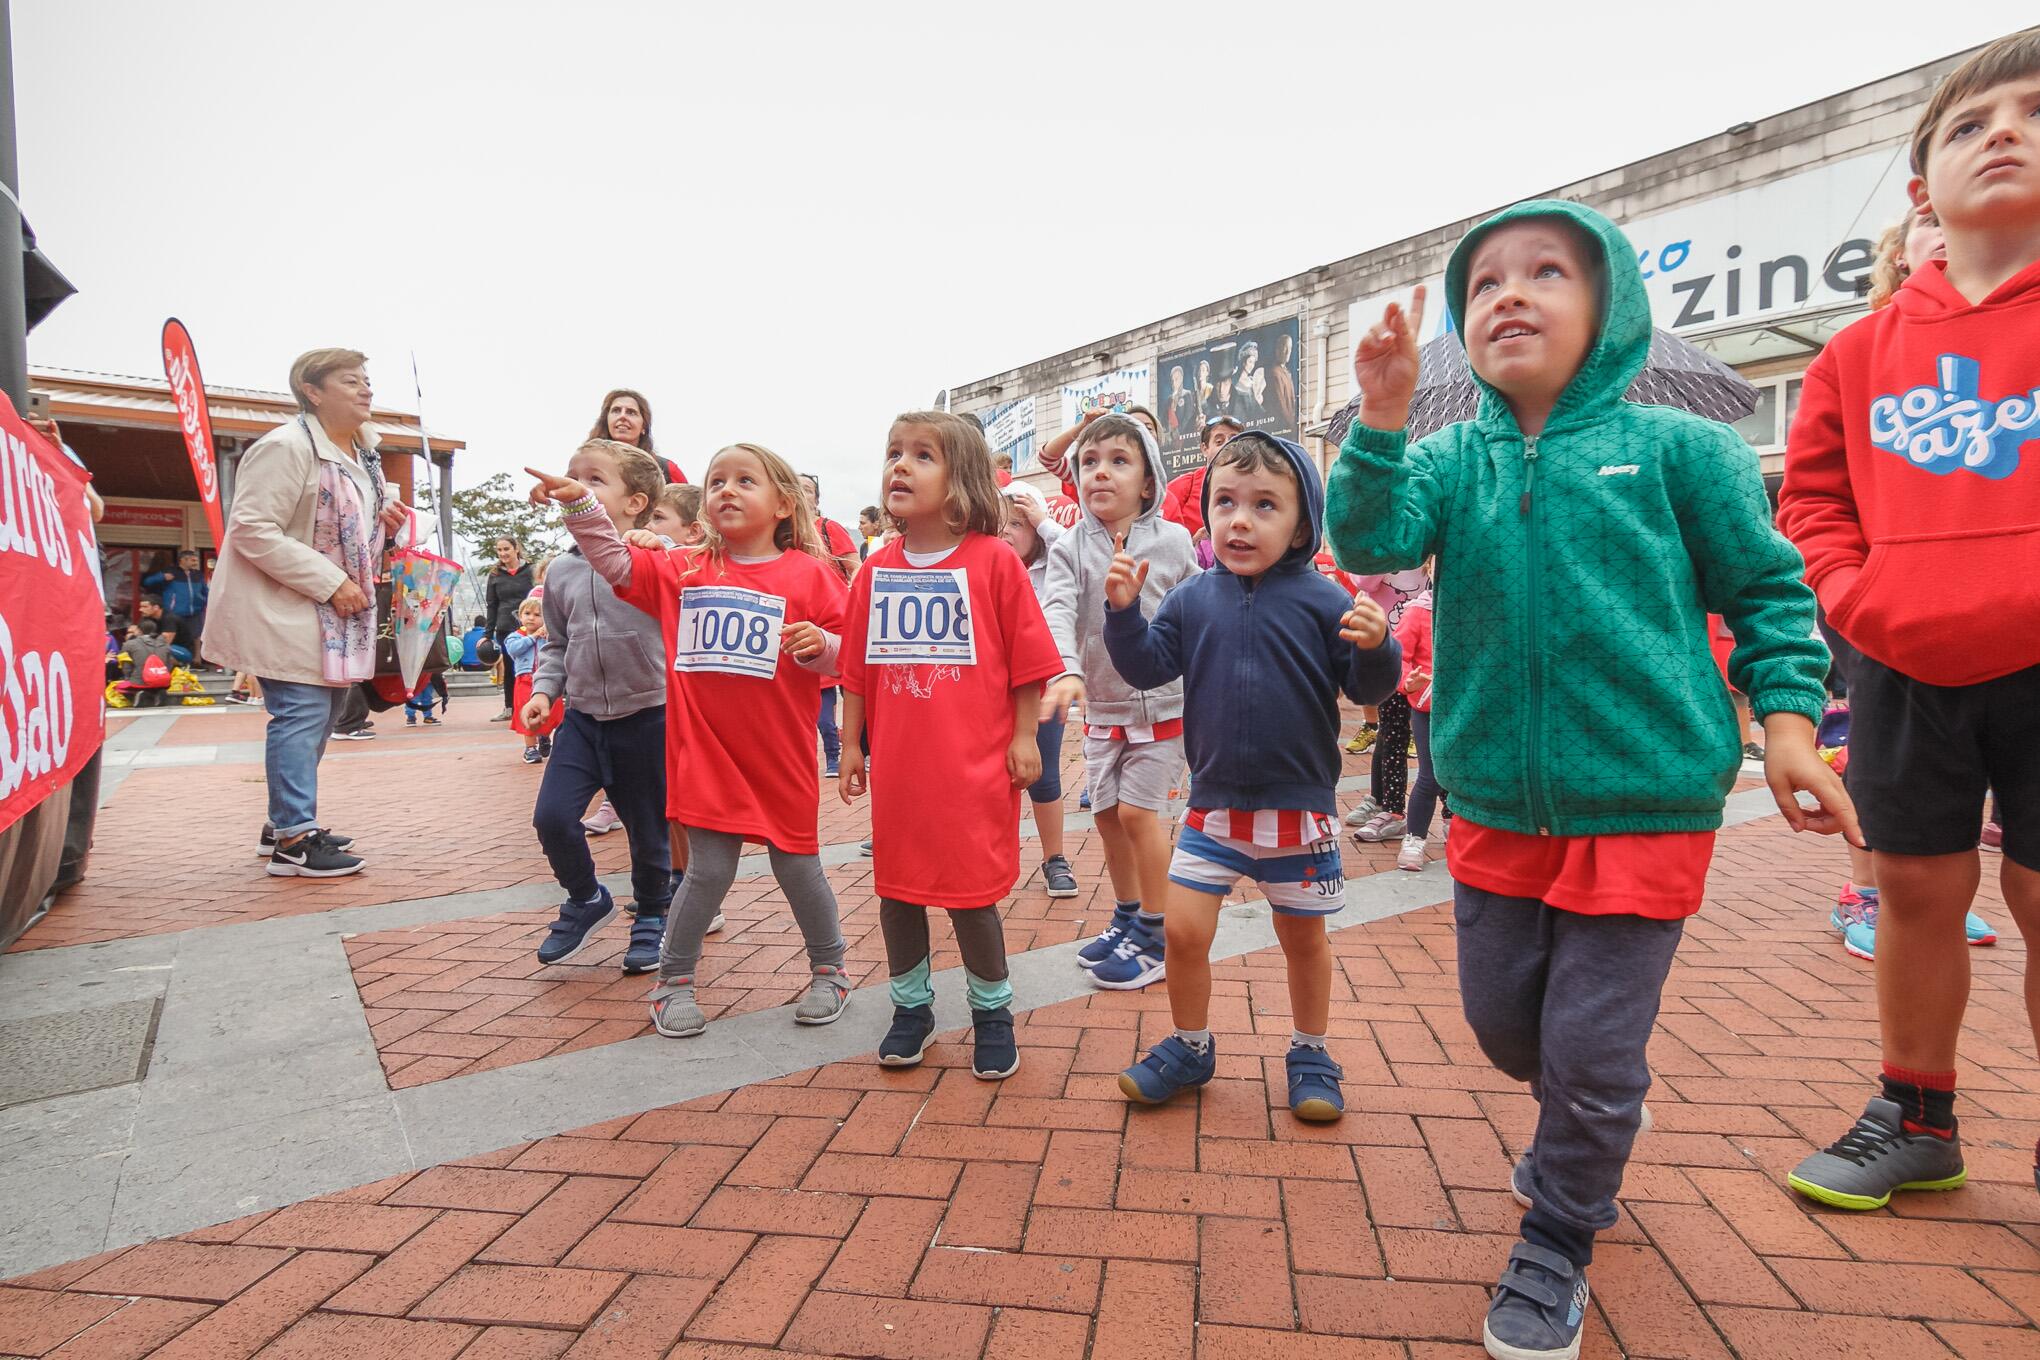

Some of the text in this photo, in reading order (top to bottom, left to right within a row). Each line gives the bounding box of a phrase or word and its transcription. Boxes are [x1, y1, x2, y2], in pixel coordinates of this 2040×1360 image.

[1256, 416, 1276, 426] JULIO
[1172, 453, 1207, 469] EMPE
[691, 609, 770, 656] 1008
[875, 595, 970, 641] 1008
